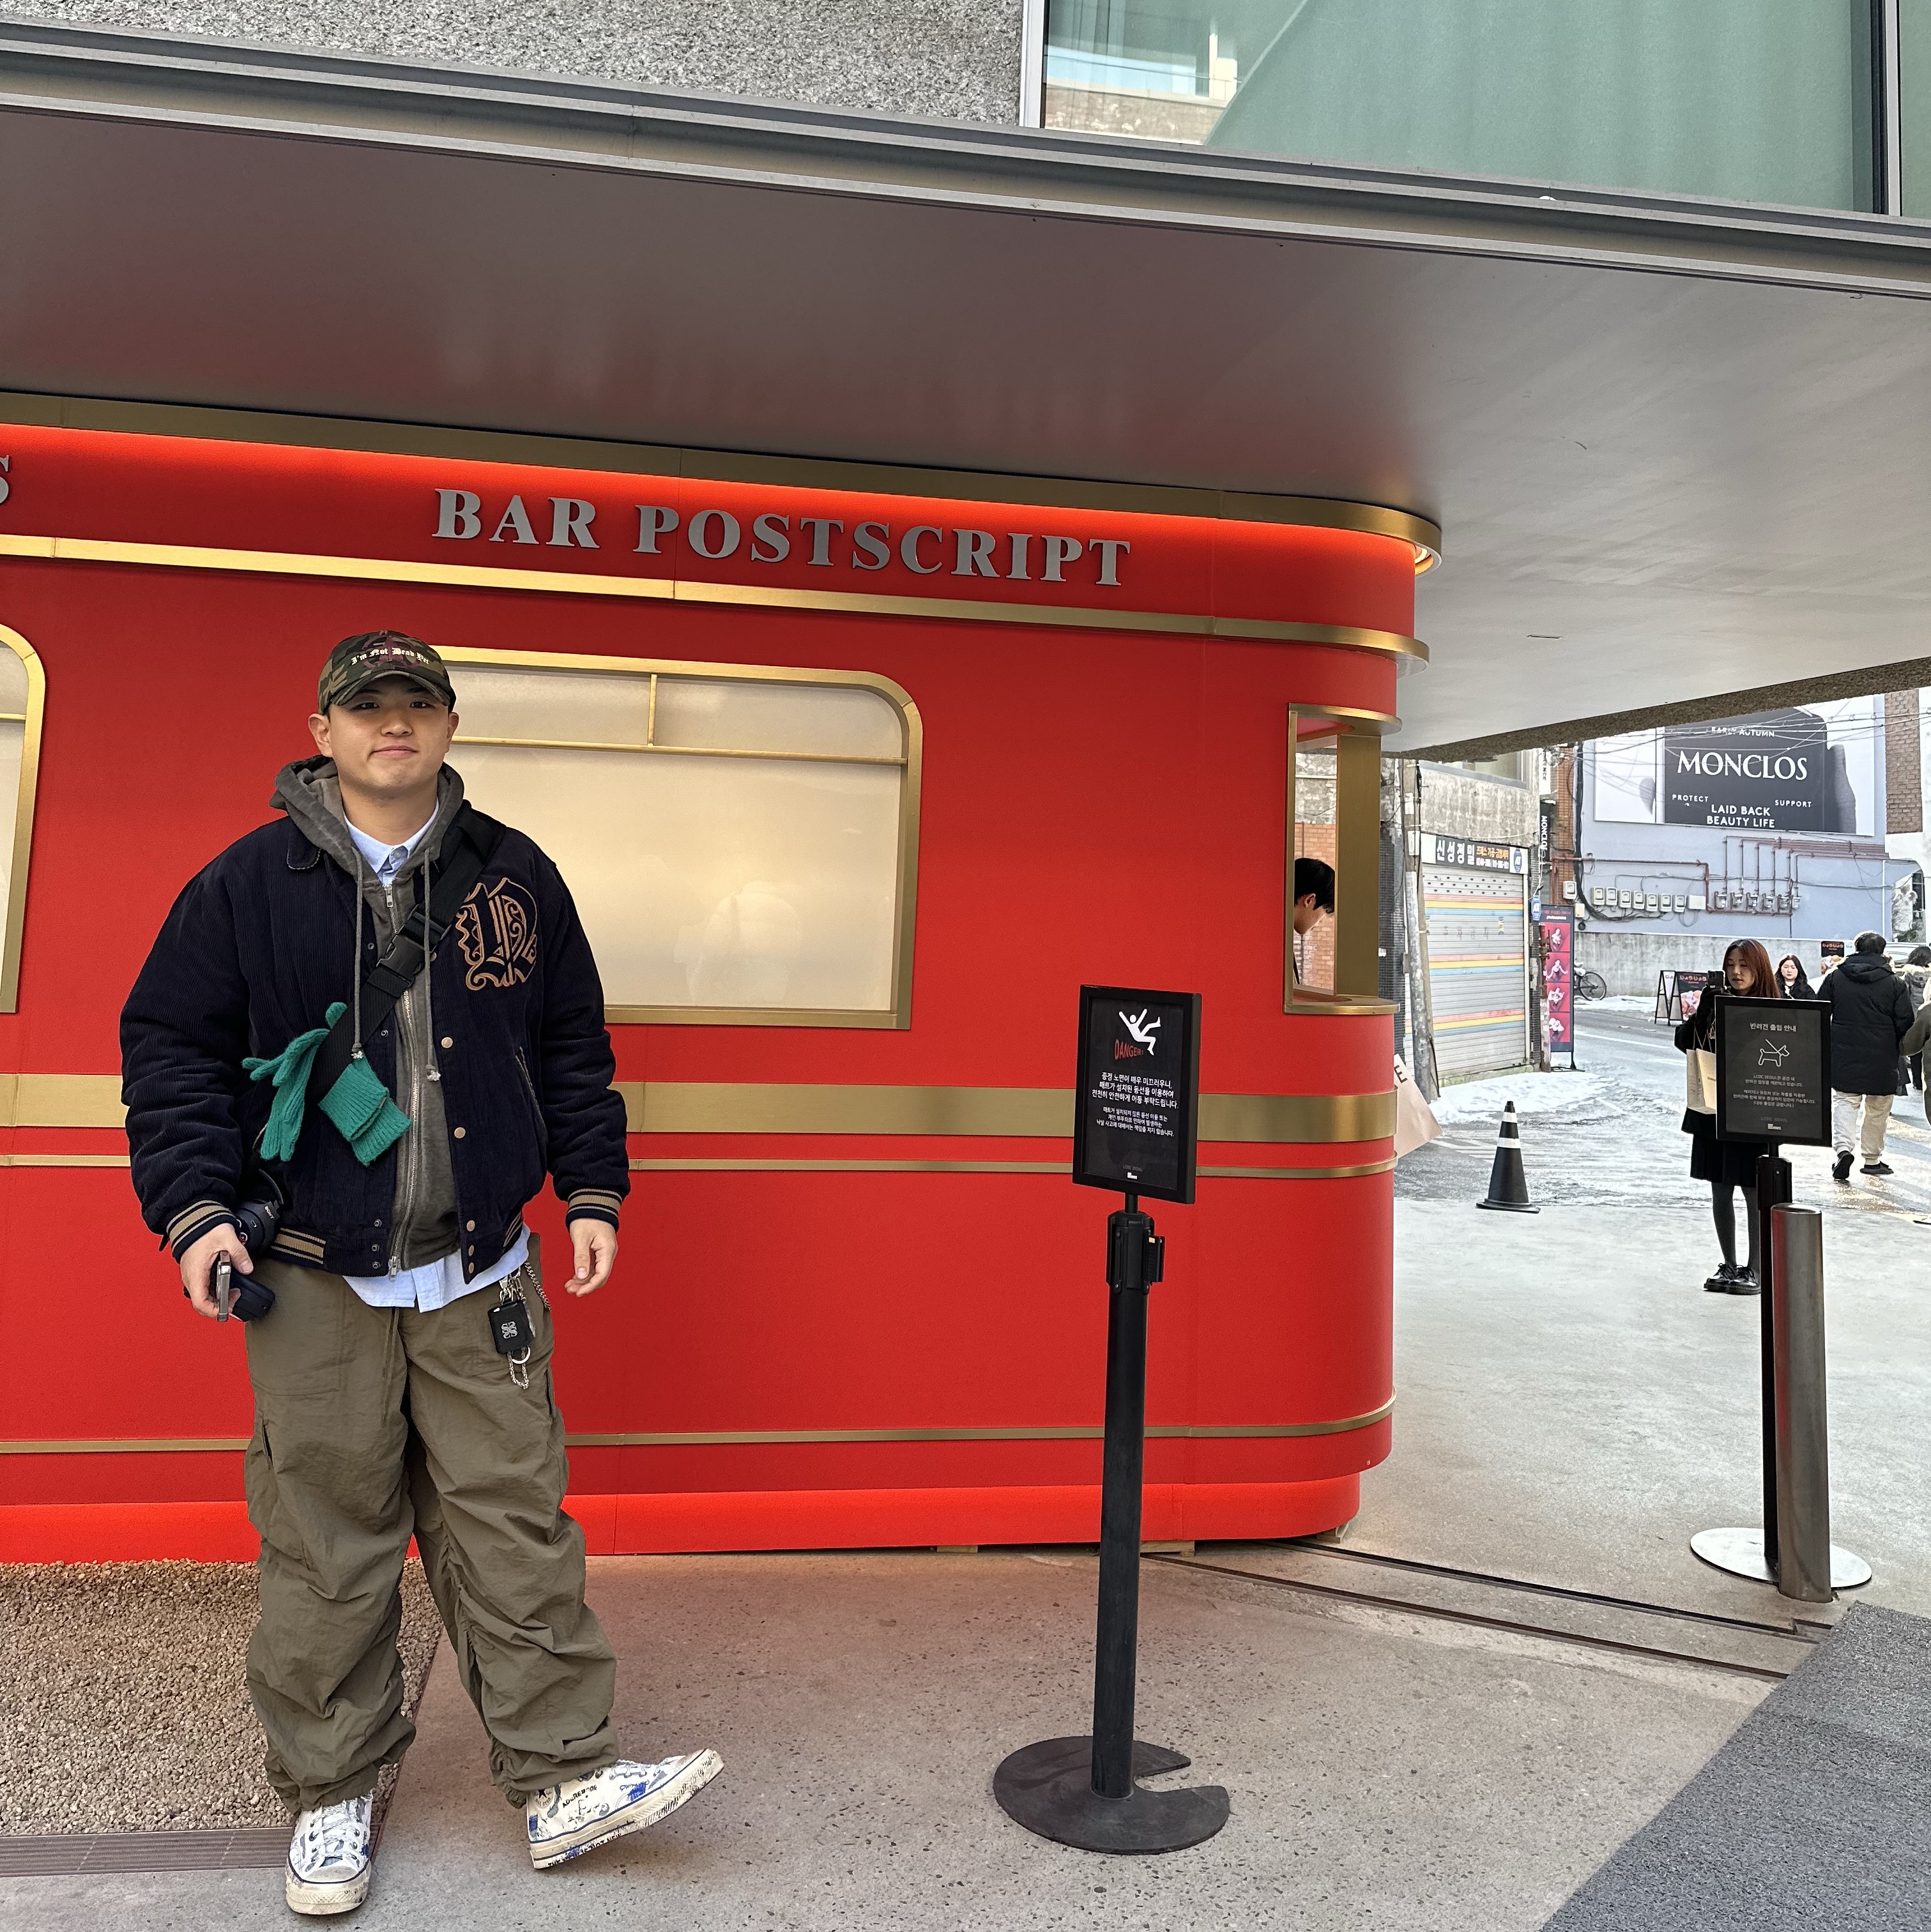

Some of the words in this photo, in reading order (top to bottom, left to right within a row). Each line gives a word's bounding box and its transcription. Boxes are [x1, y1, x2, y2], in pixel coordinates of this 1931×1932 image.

[432, 488, 600, 549] BAR
[633, 505, 1130, 586] POSTSCRIPT
[351, 654, 367, 665] I'm
[369, 647, 388, 658] Not
[392, 646, 415, 657] Dead
[416, 651, 429, 665] Yet
[1739, 729, 1775, 737] AUTUMN
[1677, 750, 1808, 780] MONCLOS
[1672, 794, 1709, 802] PROTECT
[1775, 799, 1812, 808] SUPPORT
[1711, 804, 1737, 814] LAID
[1741, 805, 1771, 816] BACK
[1707, 816, 1749, 826] BEAUTY
[1753, 818, 1775, 828] LIFE
[1437, 839, 1475, 865] 신성정밀
[1092, 1089, 1108, 1099] 천천히
[1109, 1092, 1130, 1102] 안전하게
[1132, 1095, 1142, 1104] 이동
[1144, 1097, 1179, 1109] 부탁드립니다.
[1117, 1083, 1132, 1093] 설치된
[1152, 1088, 1173, 1099] 이용하여
